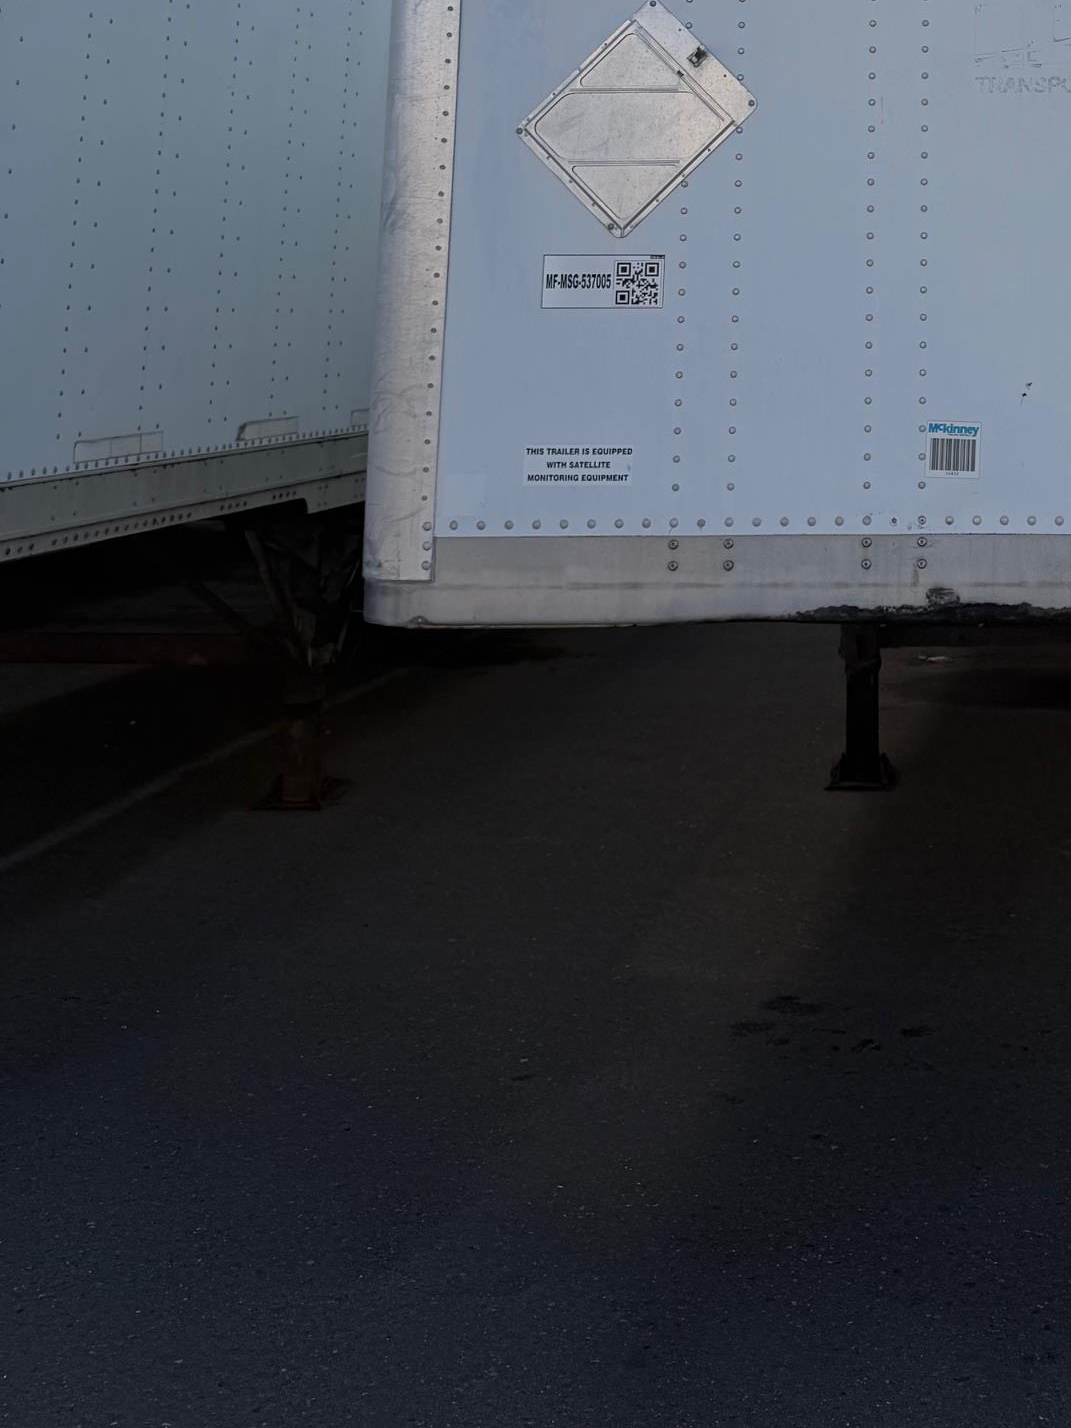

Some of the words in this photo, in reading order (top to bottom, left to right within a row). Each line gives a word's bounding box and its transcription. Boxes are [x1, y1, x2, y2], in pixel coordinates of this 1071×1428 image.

[545, 273, 612, 289] MF-MSG-537005
[526, 448, 545, 456] THIS
[546, 448, 580, 456] TRAILER
[581, 448, 590, 456] IS
[592, 448, 633, 456] EQUIPPED
[546, 461, 567, 469] WITH
[569, 461, 611, 469] SATELLITE
[527, 474, 579, 482] MONITORING
[581, 474, 629, 482] EQUIPMENT
